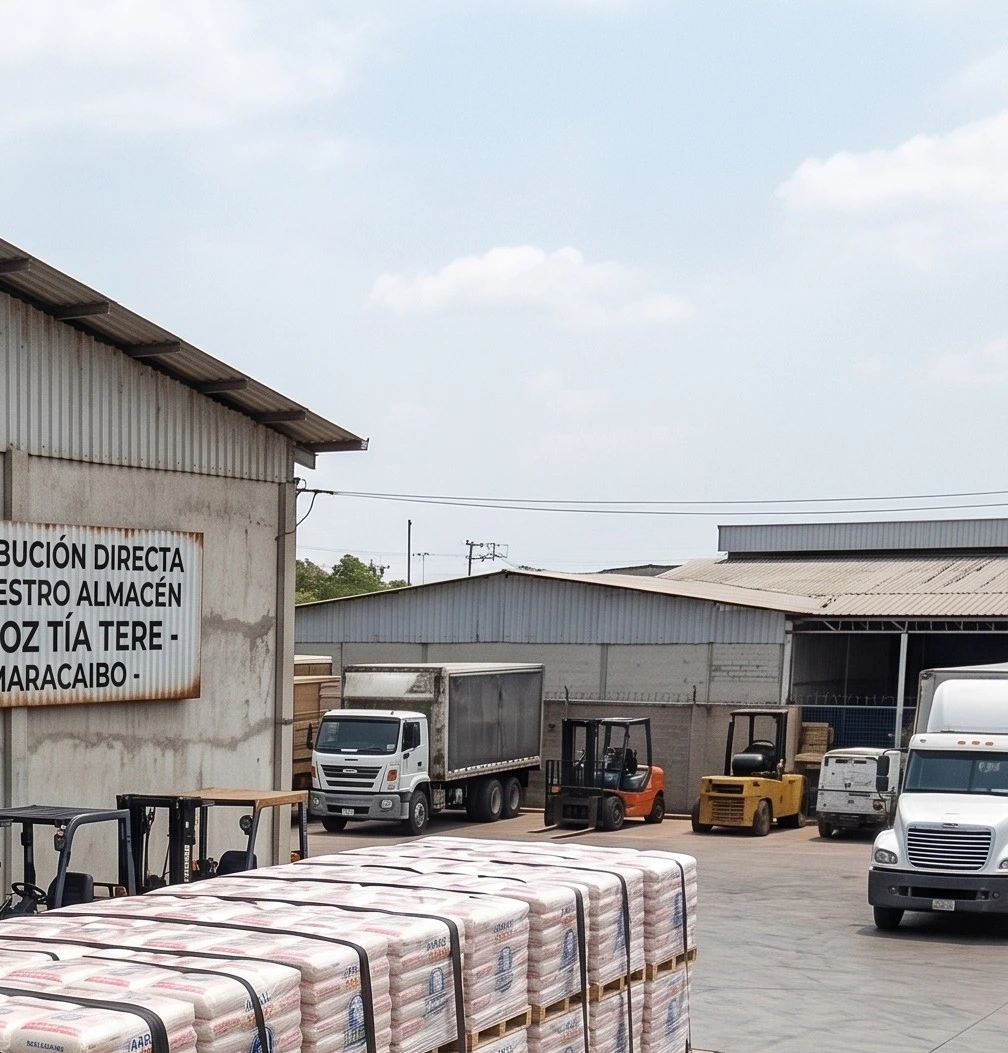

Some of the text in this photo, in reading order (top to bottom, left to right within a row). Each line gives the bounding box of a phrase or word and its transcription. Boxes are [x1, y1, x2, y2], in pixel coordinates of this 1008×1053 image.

[94, 544, 185, 573] DIRECTA
[76, 577, 182, 608] ALMACÉN
[48, 612, 92, 652] TÍA
[99, 621, 163, 651] TERE
